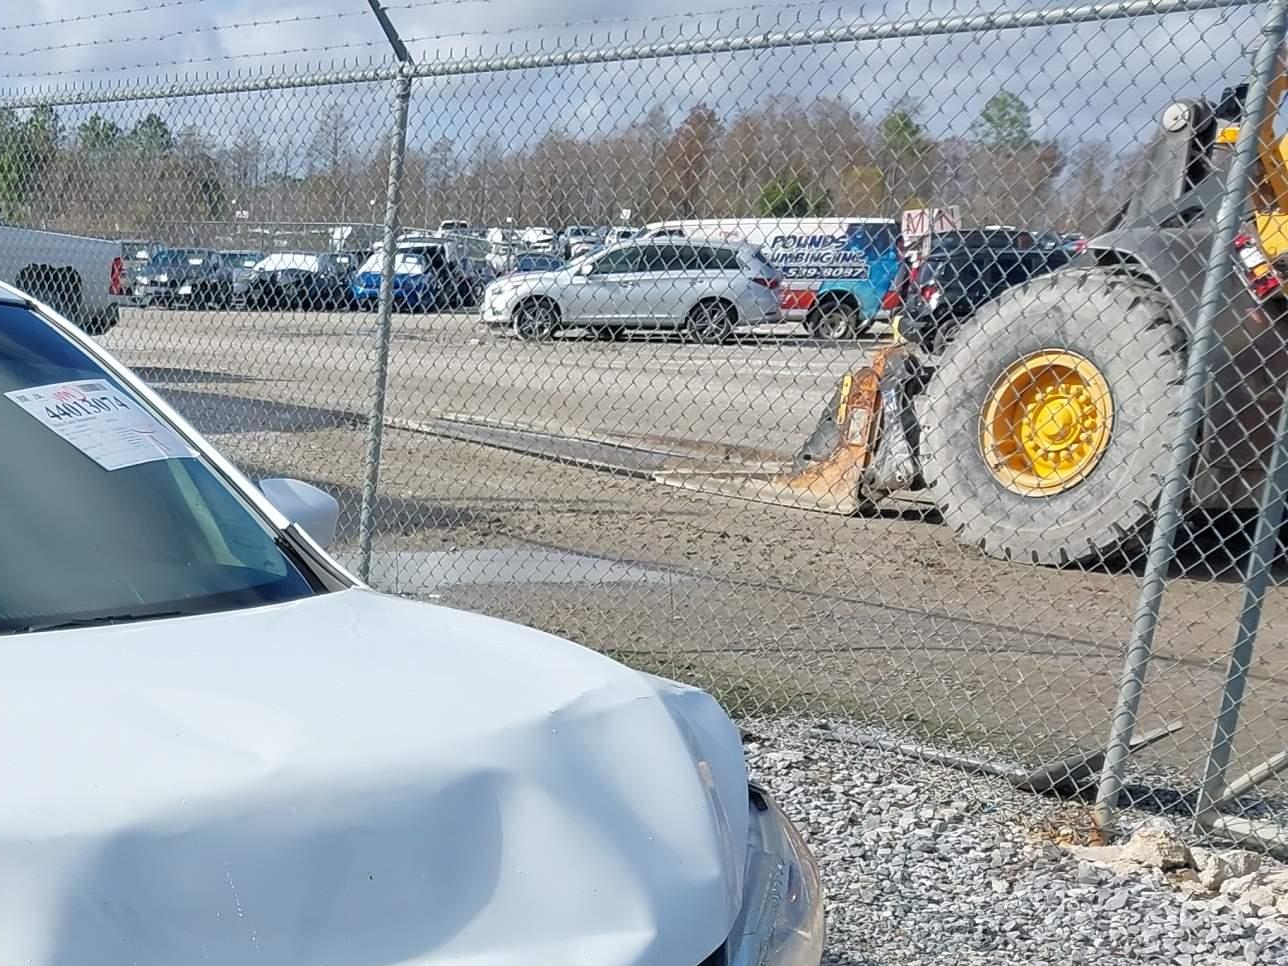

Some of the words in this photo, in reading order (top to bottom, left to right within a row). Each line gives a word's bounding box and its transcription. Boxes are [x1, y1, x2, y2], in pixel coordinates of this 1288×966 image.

[771, 234, 848, 249] POUNDS
[769, 251, 833, 264] UMBING
[45, 396, 130, 421] 44013074
